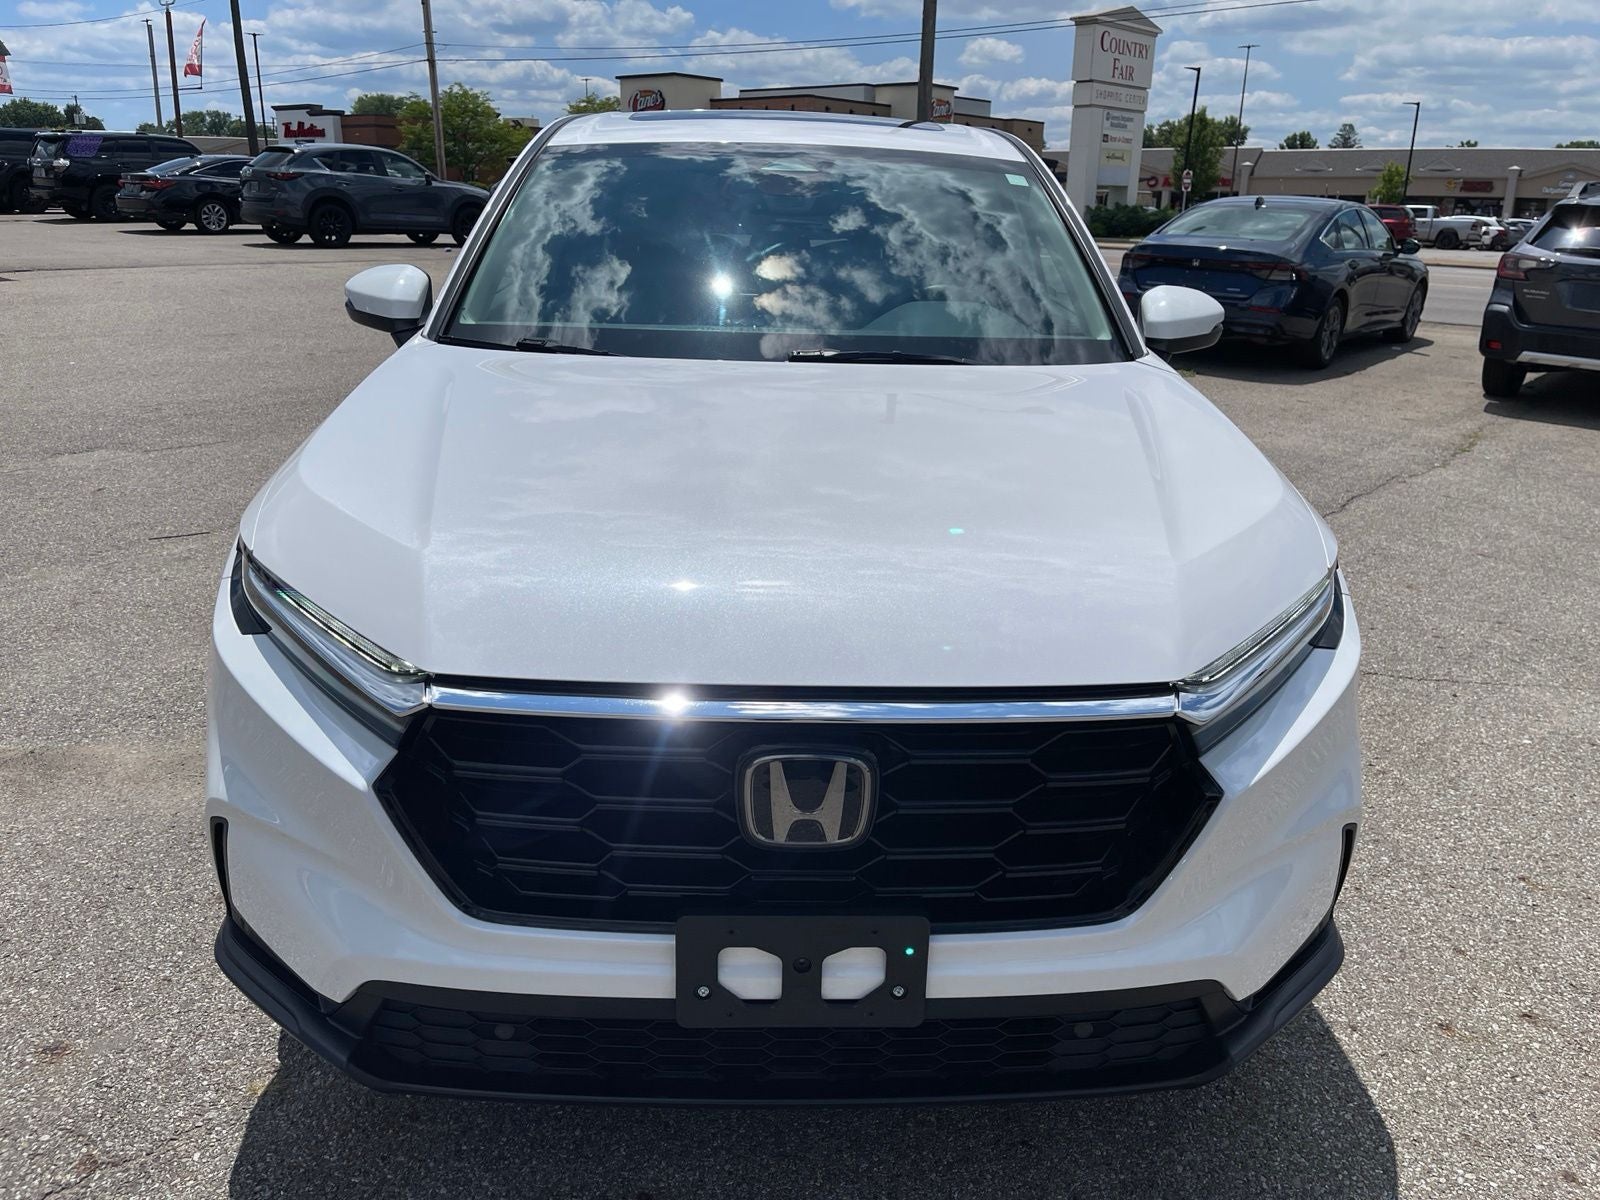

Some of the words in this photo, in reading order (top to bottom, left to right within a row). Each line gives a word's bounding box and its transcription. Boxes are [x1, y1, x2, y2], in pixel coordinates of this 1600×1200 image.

[1100, 30, 1150, 60] COUNTRY
[1112, 58, 1135, 81] FAIR
[1095, 89, 1122, 102] SHOPPING
[1124, 93, 1146, 105] CENTER
